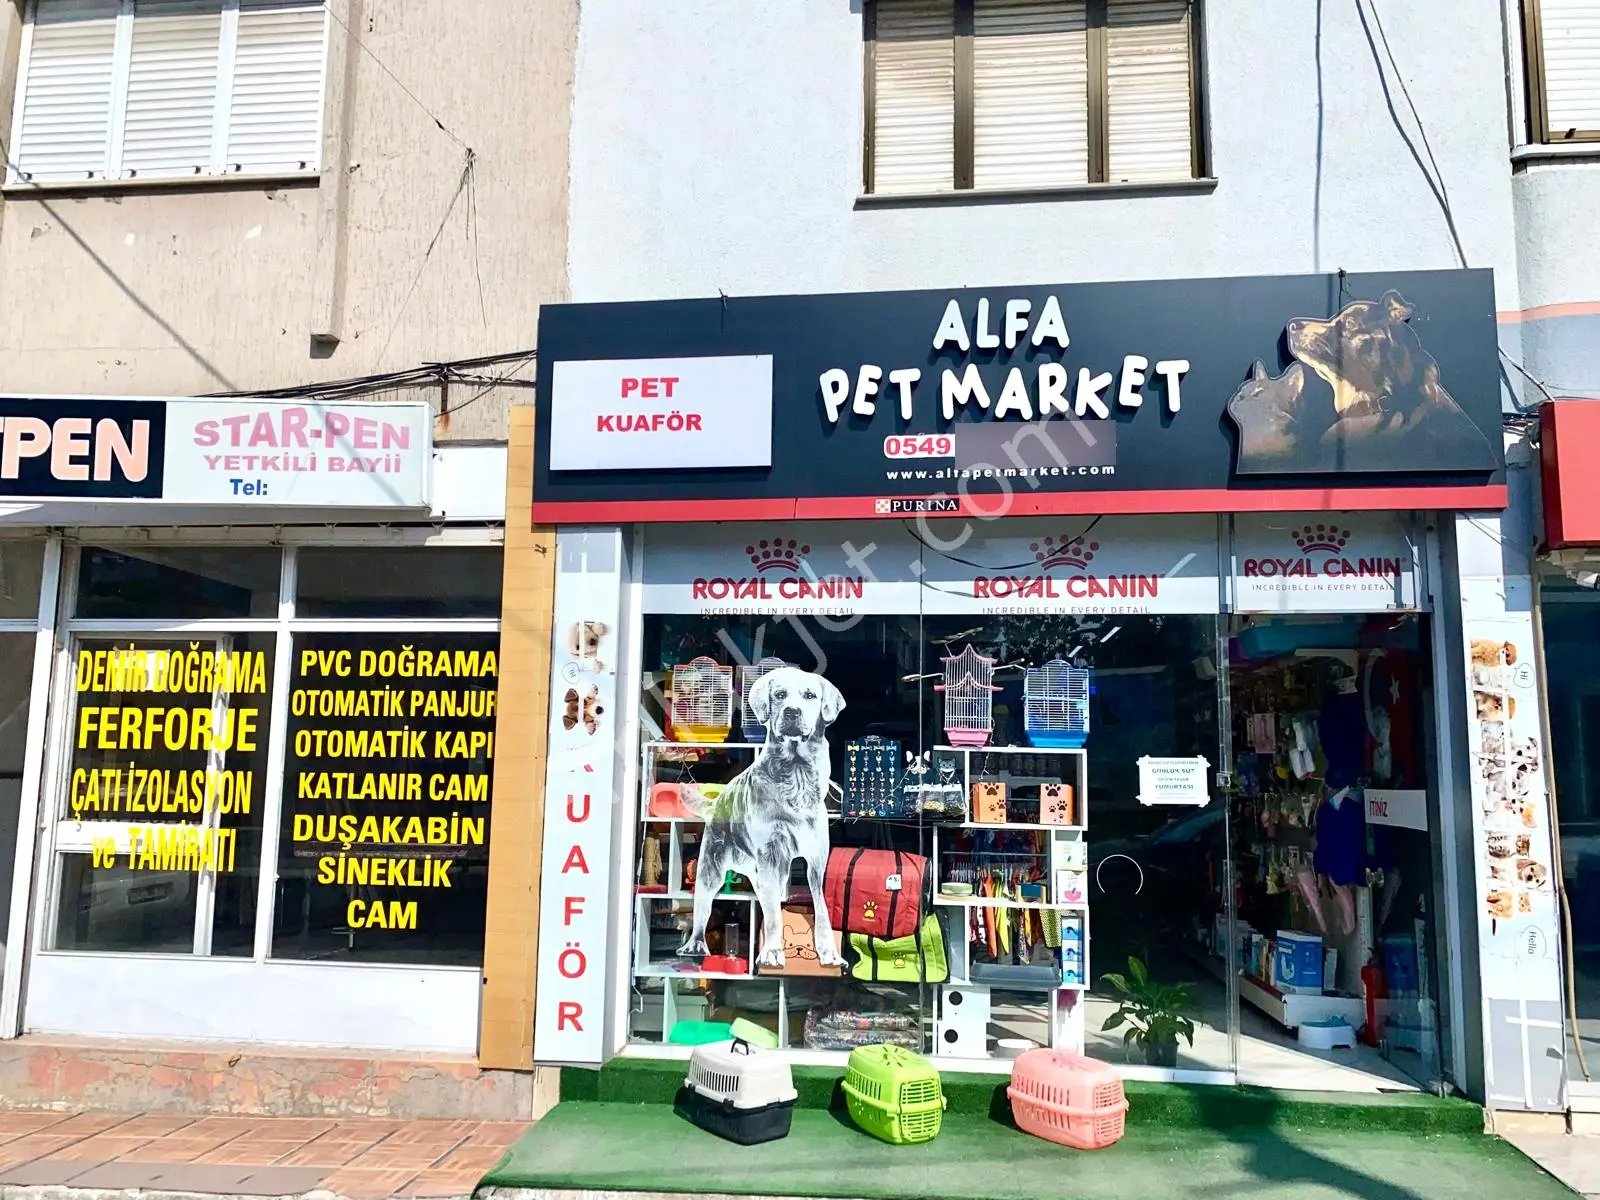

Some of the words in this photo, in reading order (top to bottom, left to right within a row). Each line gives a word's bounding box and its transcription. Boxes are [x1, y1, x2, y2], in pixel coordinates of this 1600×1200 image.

[933, 295, 1070, 351] ALFA
[621, 377, 679, 398] PET
[819, 364, 921, 423] PET
[941, 355, 1190, 420] MARKET
[193, 407, 410, 450] STAR-PEN
[597, 410, 702, 432] KUAFÖR
[0, 416, 150, 483] PEN
[203, 452, 317, 472] YETKİLİ
[885, 437, 951, 456] 0549
[230, 478, 268, 496] Tel:
[892, 499, 958, 512] PURINA
[1244, 558, 1318, 578] ROYAL
[1323, 557, 1401, 578] CANIN
[693, 577, 772, 600] ROYAL
[778, 576, 863, 600] CANIN
[974, 575, 1059, 598] ROYAL
[1066, 574, 1158, 598] CANIN
[1252, 583, 1309, 591] INCREDIBLE
[1314, 583, 1323, 591] IN
[1328, 583, 1357, 591] EVERY
[700, 607, 761, 615] INCREDIBLE
[767, 607, 778, 615] IN
[782, 607, 814, 615] EVERY
[819, 607, 855, 615] DETAIL
[982, 606, 1049, 614] INCREDIBLE
[1054, 606, 1065, 614] IN
[1071, 606, 1105, 614] EVERY
[1111, 606, 1150, 614] DETAIL
[76, 642, 147, 692] DEMİR
[153, 641, 266, 694] DOĞRAMA
[300, 650, 351, 677] PVC
[359, 644, 499, 677] DOĞRAMA
[292, 685, 404, 717] OTOMATİK
[78, 707, 258, 752] FERFORJE
[295, 725, 426, 758] OTOMATİK
[434, 731, 493, 759] KAPI
[71, 768, 121, 823] ÇATI
[126, 761, 252, 815] İZOLASYON
[298, 772, 422, 801] KATLANIR
[429, 773, 488, 802] CAM
[92, 835, 116, 869] ve
[128, 820, 237, 873] TAMİRATI
[293, 812, 485, 850] DUŞAKABİN
[317, 853, 453, 888] SİNEKLİK
[558, 764, 593, 1031] UAFÖR
[347, 899, 418, 930] CAM
